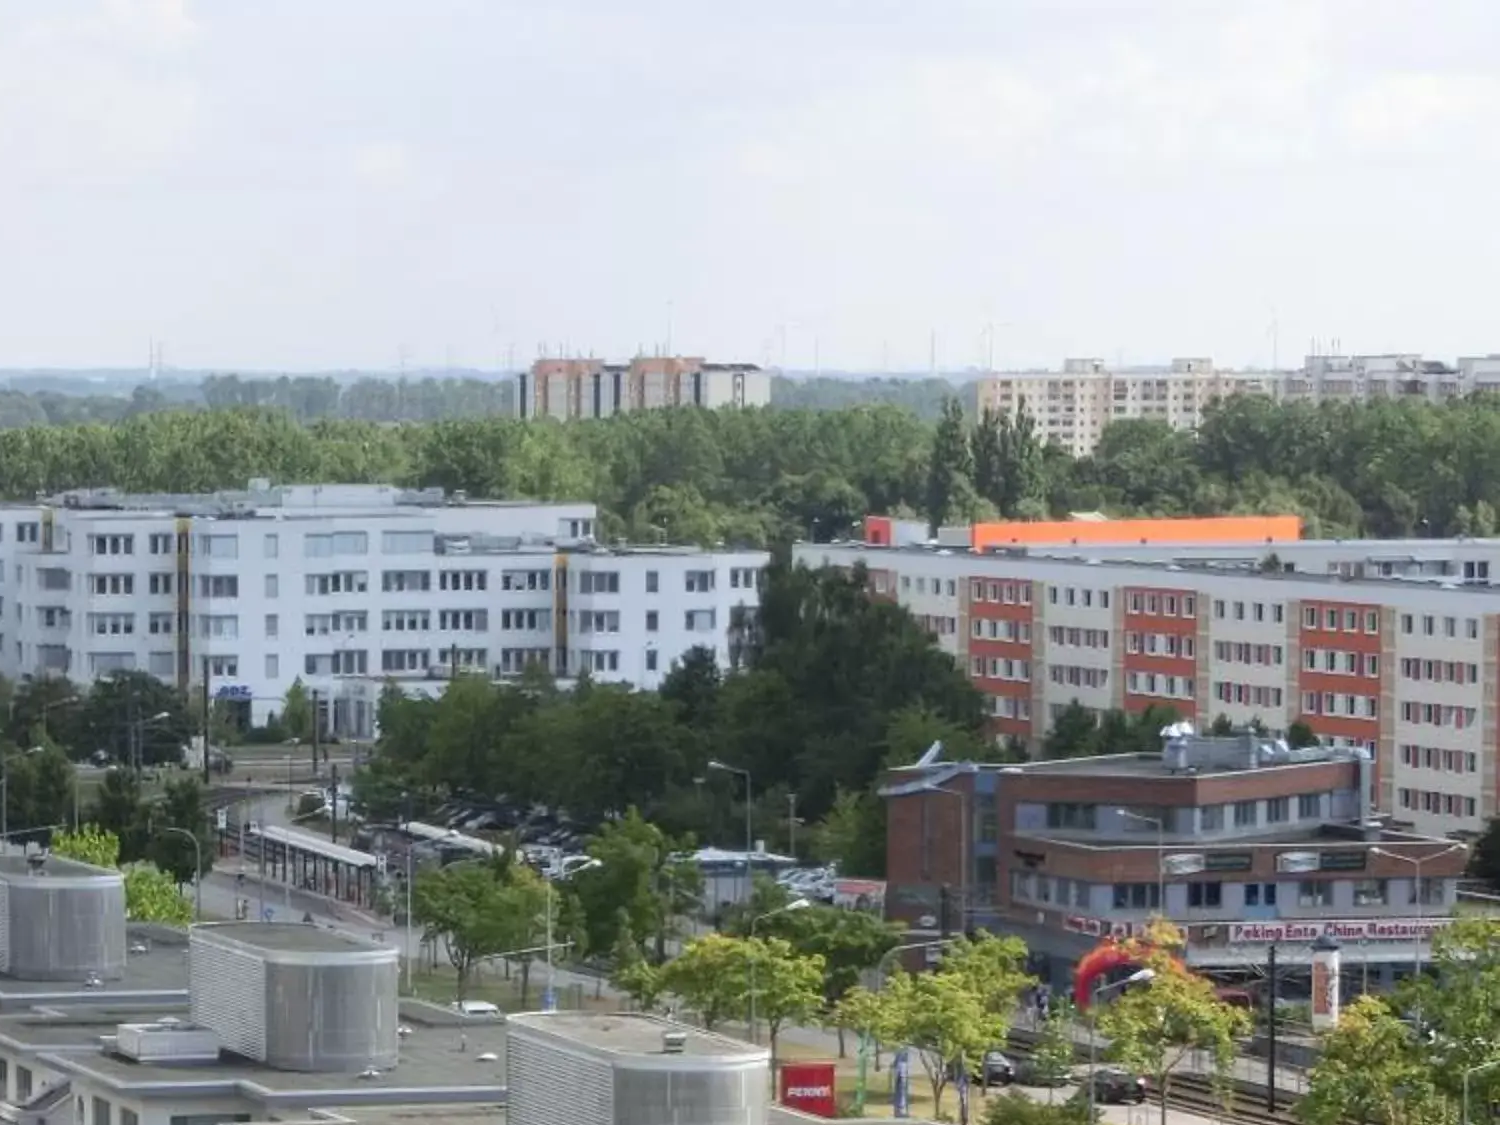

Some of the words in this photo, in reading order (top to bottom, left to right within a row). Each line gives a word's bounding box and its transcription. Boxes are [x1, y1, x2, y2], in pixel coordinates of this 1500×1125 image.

[1236, 923, 1282, 940] Peking
[1286, 924, 1317, 938] Ente
[1324, 922, 1363, 937] China
